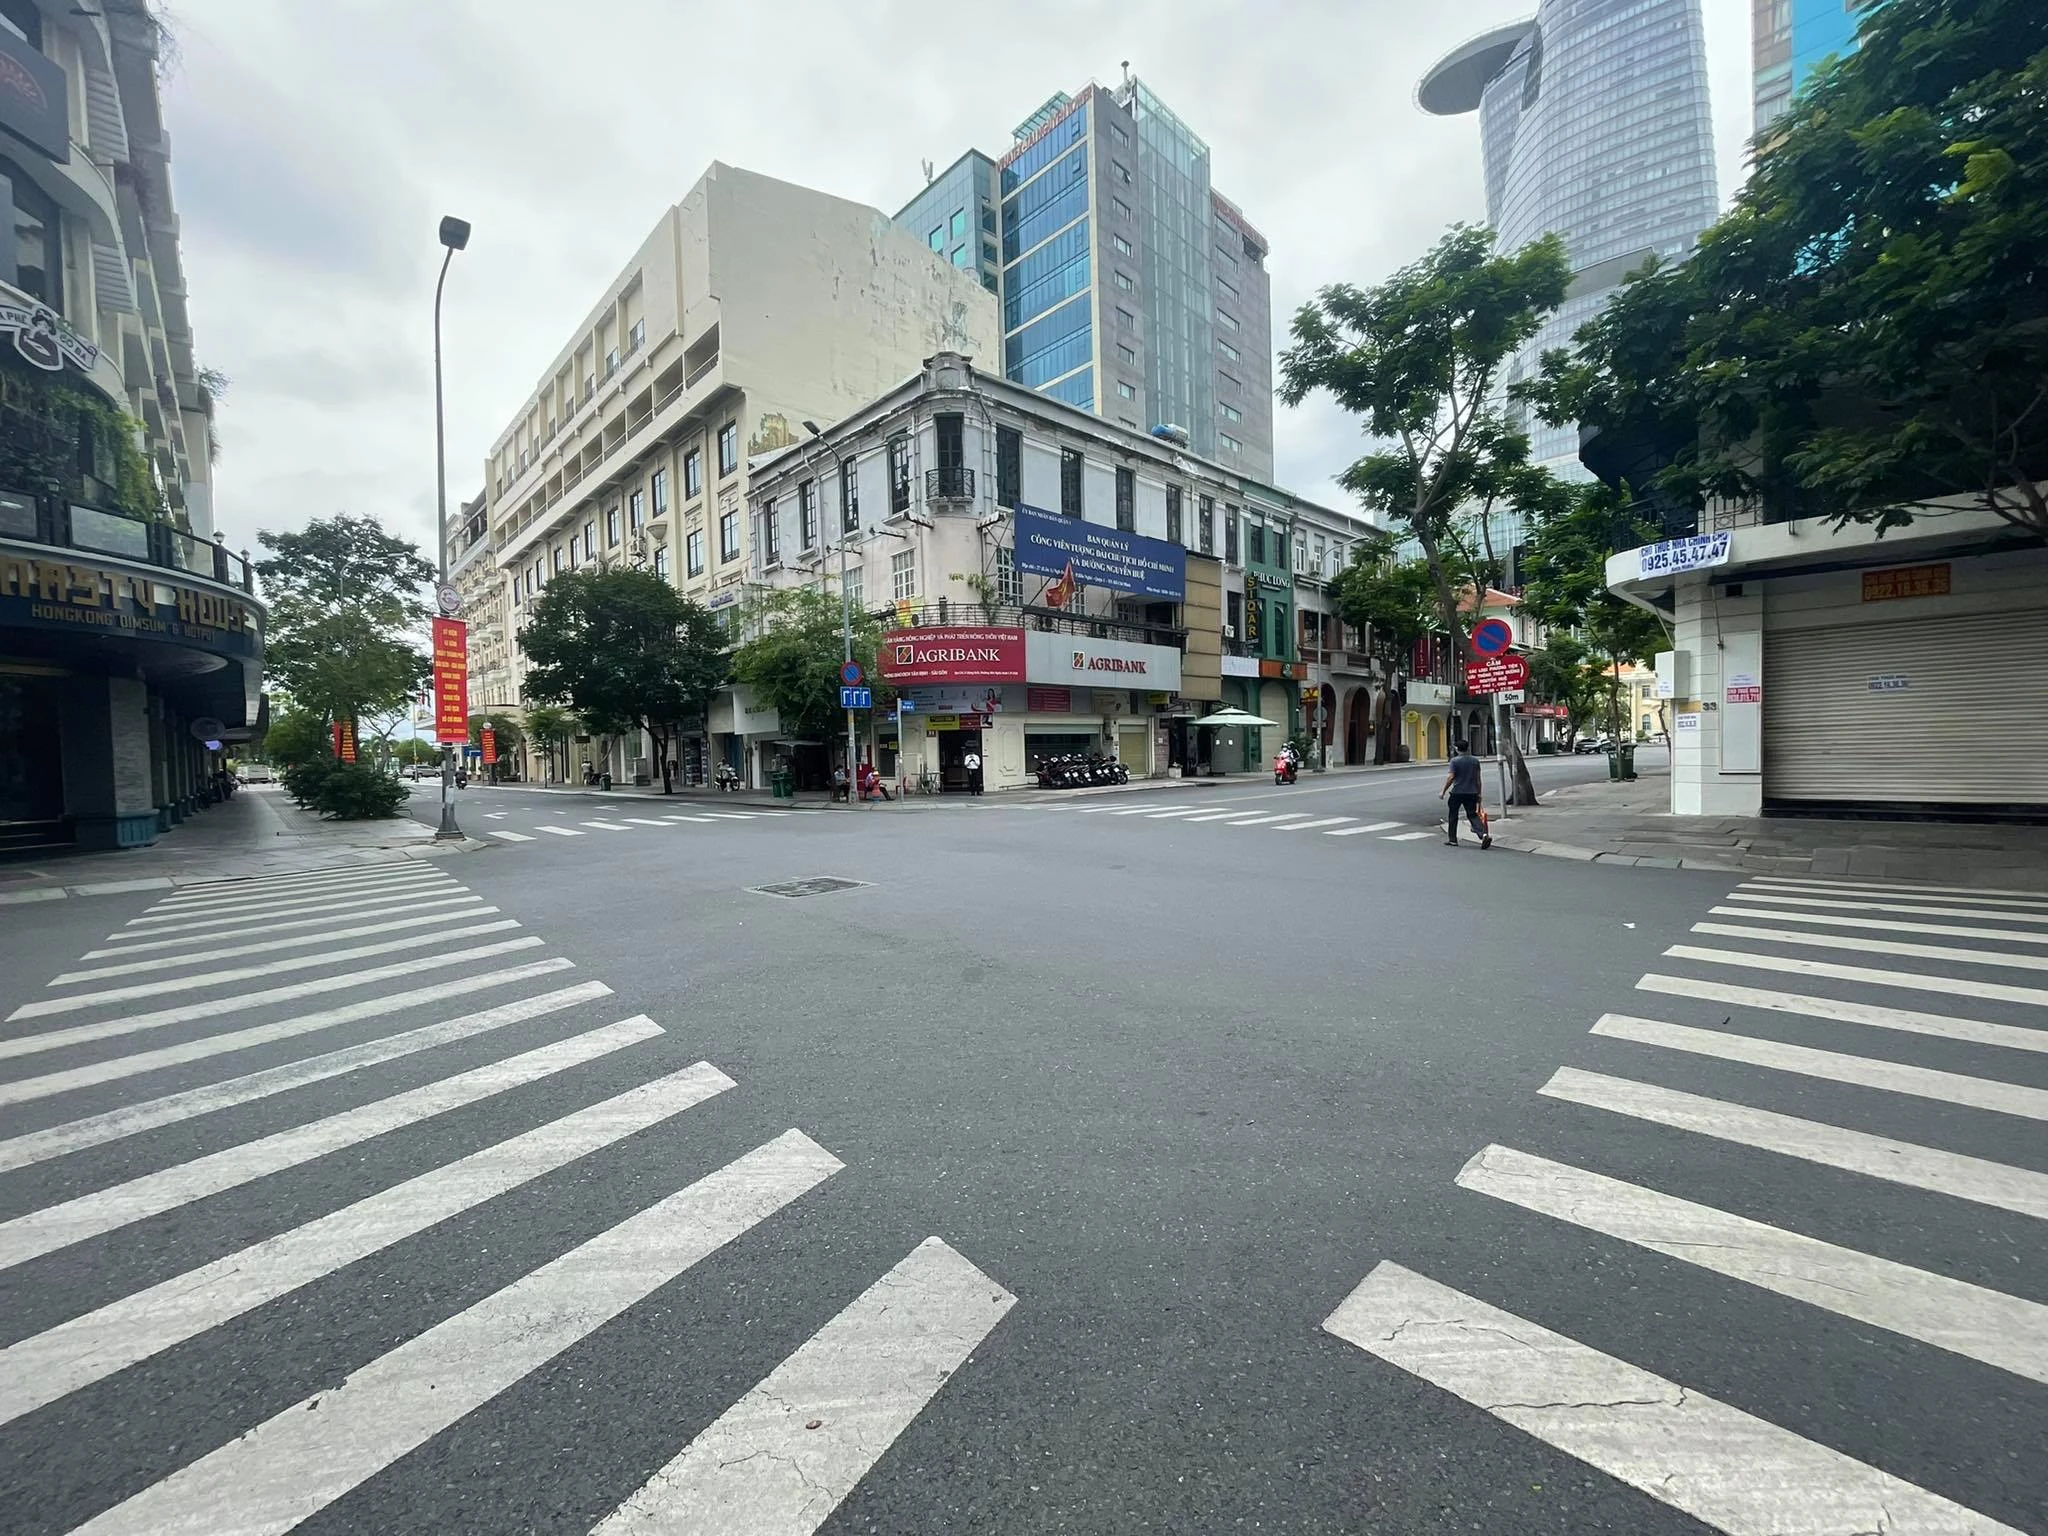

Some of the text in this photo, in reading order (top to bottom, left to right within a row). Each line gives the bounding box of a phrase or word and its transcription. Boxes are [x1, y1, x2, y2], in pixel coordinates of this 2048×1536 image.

[1087, 534, 1101, 544] BAN
[1641, 541, 1728, 573] 0925.45.47.47
[1272, 576, 1290, 588] LONG
[32, 603, 113, 626] HONGKONG
[119, 615, 167, 633] DIMSUM
[916, 648, 1000, 663] AGRIBANK
[1088, 657, 1147, 674] AGRIBANK
[1504, 693, 1519, 701] 50m
[1702, 702, 1717, 711] 33
